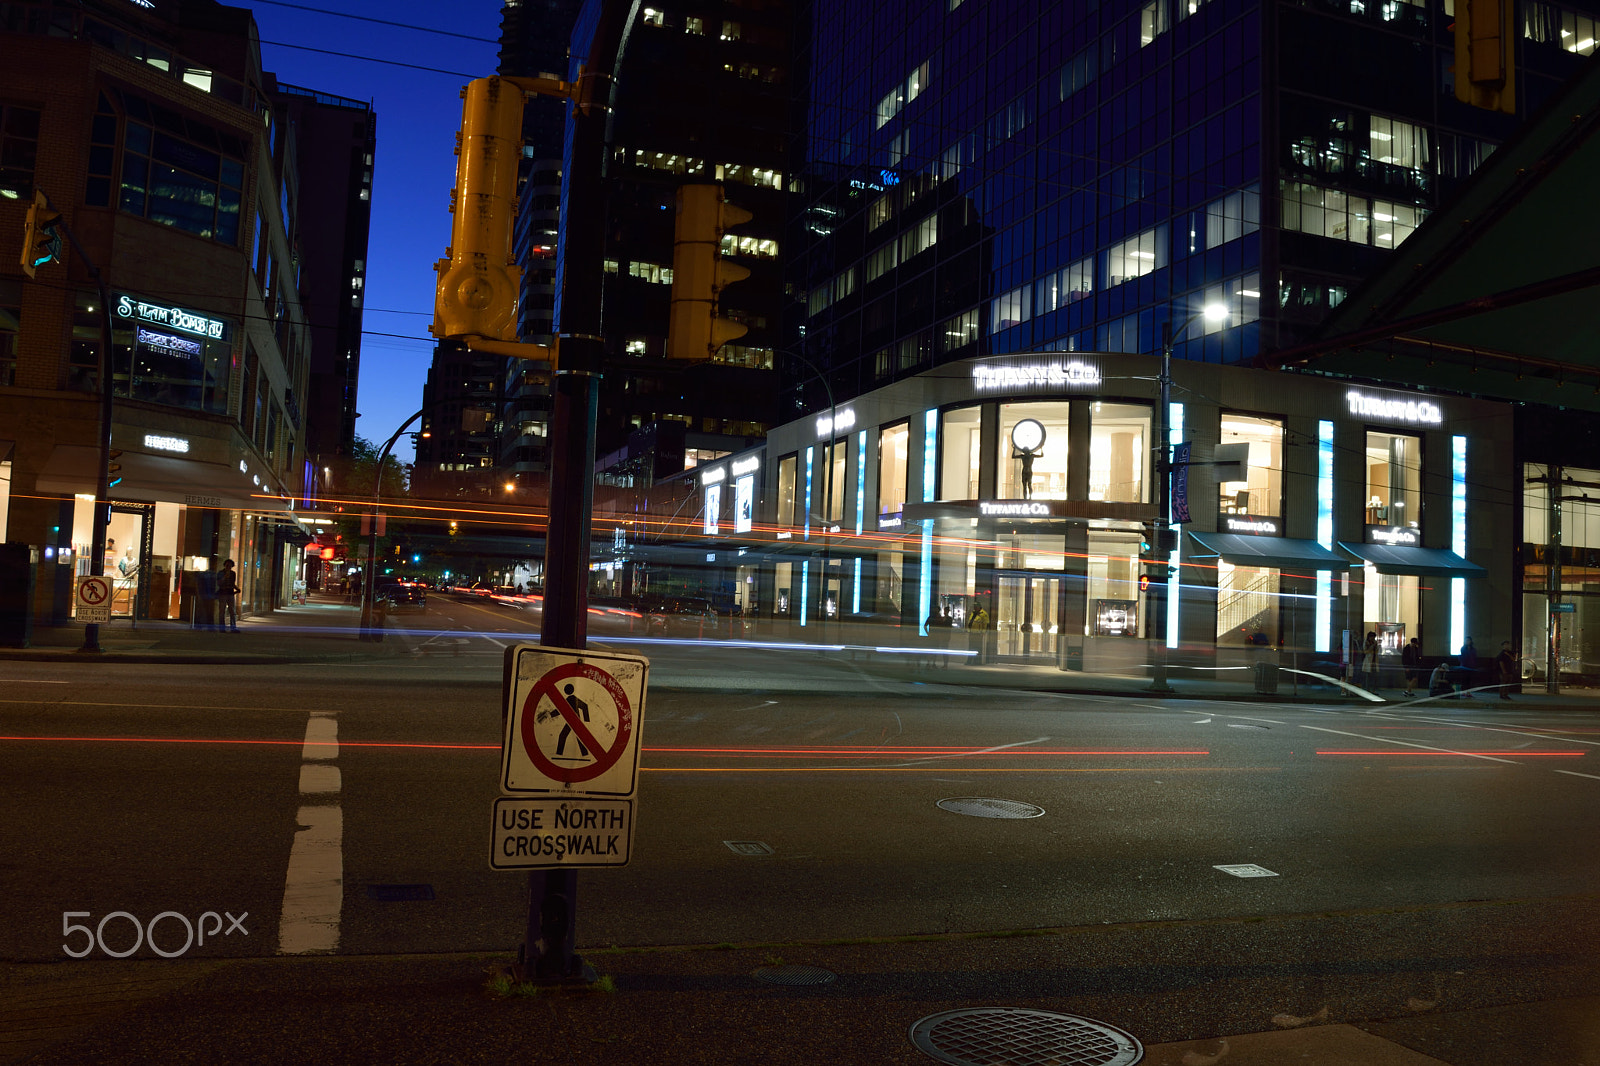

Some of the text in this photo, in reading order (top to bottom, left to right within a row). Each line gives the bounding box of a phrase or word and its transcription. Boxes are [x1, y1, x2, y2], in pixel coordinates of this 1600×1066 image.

[170, 308, 223, 337] BOMBAY
[502, 809, 624, 830] USE NORTH
[503, 835, 619, 857] CROSSWALK
